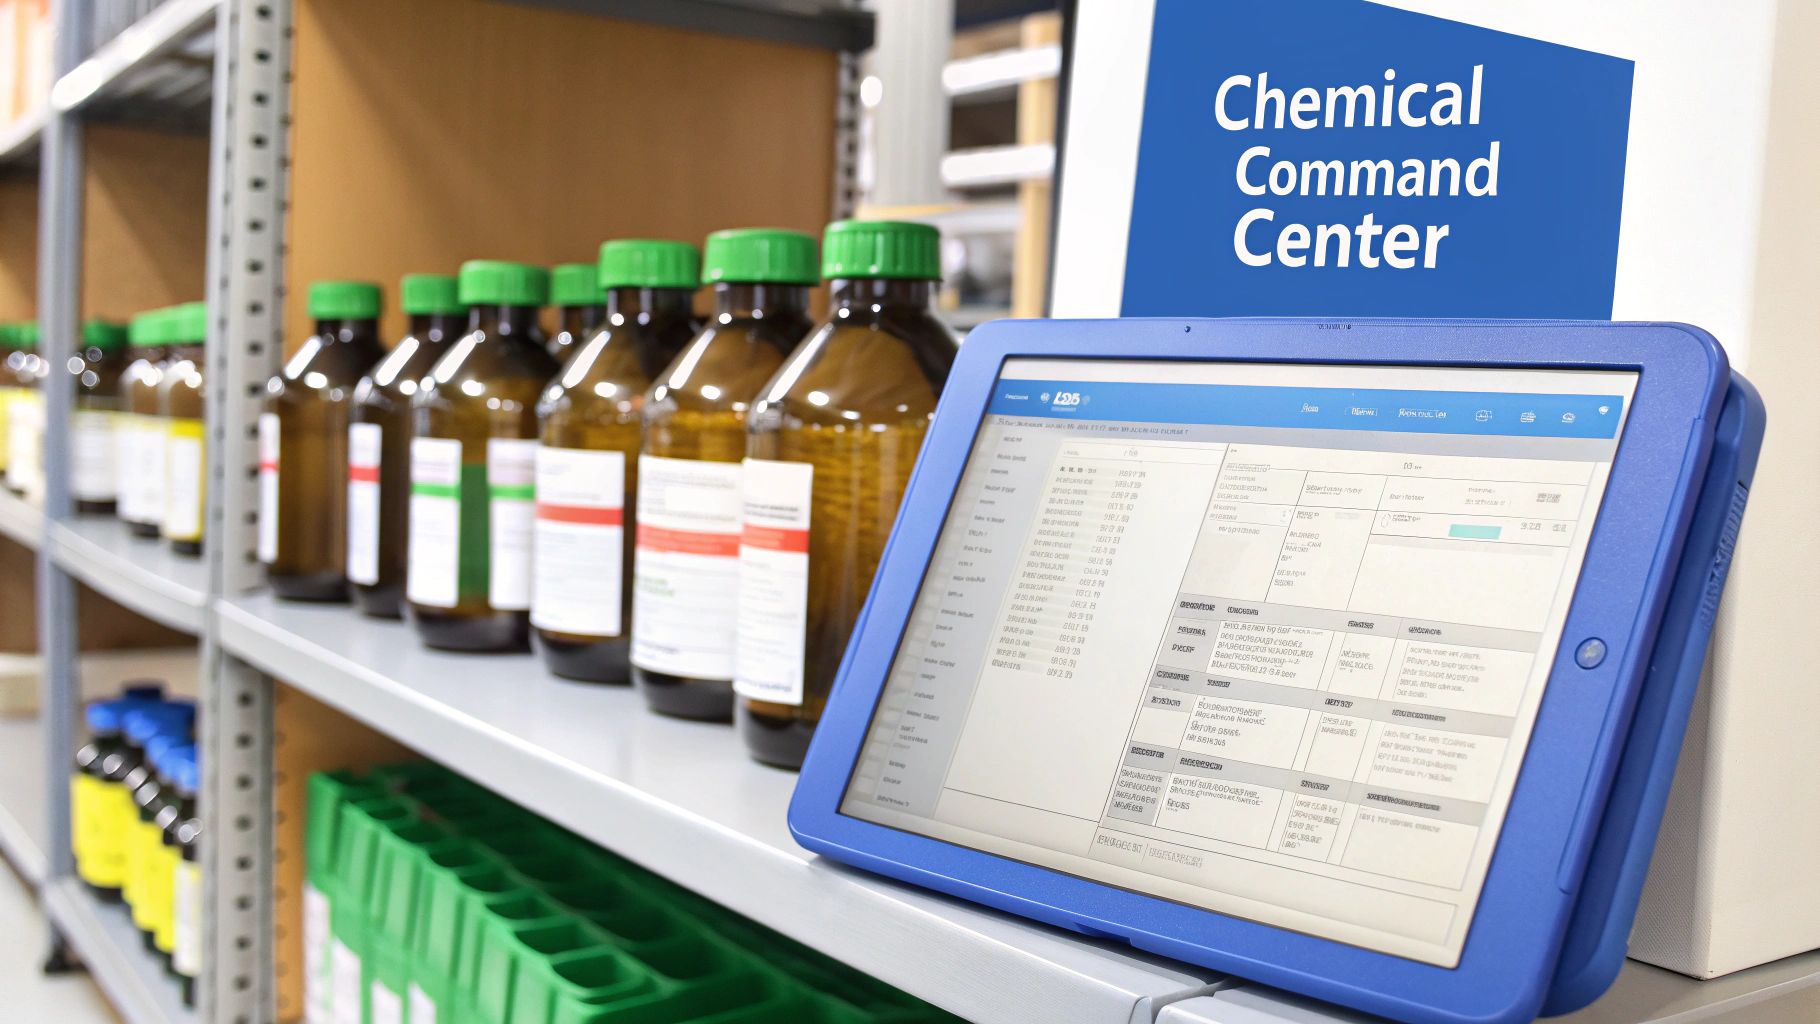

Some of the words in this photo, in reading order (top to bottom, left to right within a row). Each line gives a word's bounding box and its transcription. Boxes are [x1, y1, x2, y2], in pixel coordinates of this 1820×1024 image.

[1215, 64, 1484, 131] Chemical
[1235, 140, 1500, 197] Command
[1233, 208, 1450, 269] Center
